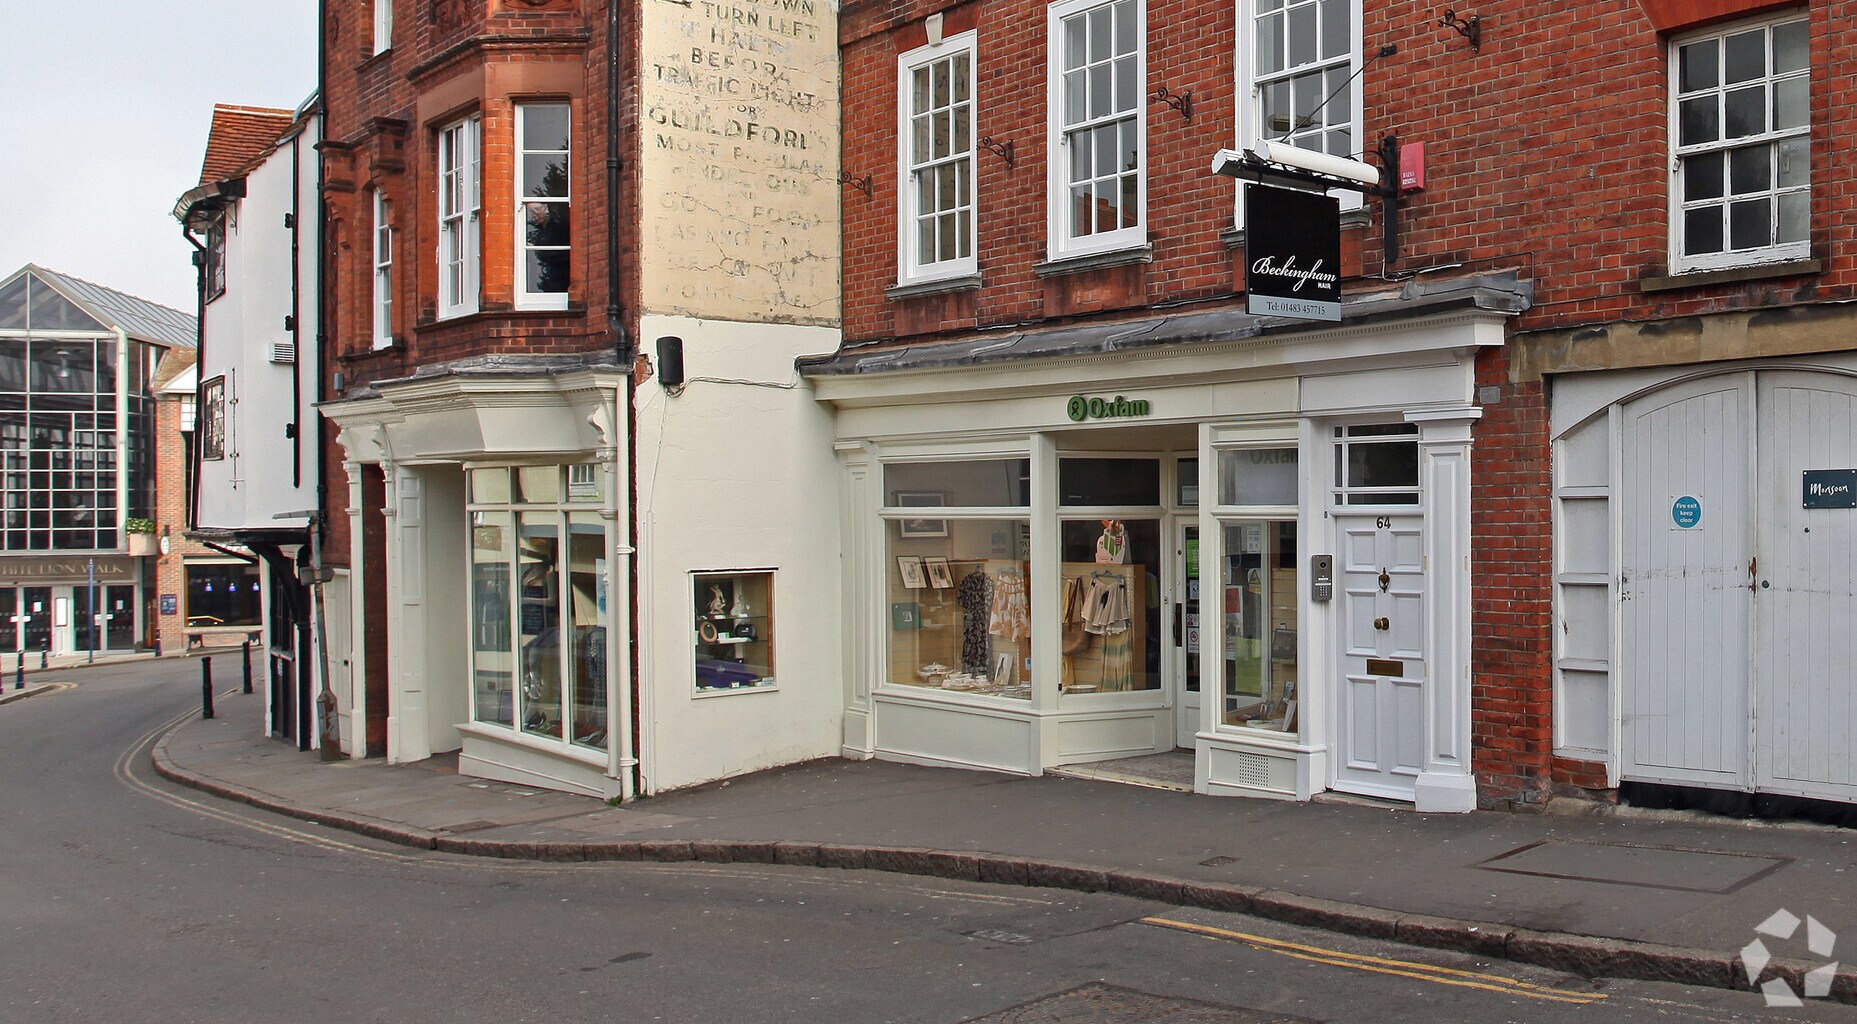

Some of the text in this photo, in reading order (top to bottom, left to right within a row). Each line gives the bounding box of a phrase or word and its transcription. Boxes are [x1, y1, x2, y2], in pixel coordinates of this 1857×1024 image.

[700, 0, 819, 41] TURN LEFT
[691, 47, 785, 81] BEFOR
[1252, 255, 1336, 292] Beckingham
[1317, 282, 1332, 290] HAIR
[1266, 301, 1326, 315] Tel: 01483 457715
[1088, 395, 1149, 418] Oxfam
[1810, 483, 1848, 496] Monsoon
[1376, 516, 1392, 529] 64
[40, 564, 76, 574] LION
[80, 564, 123, 574] WALK
